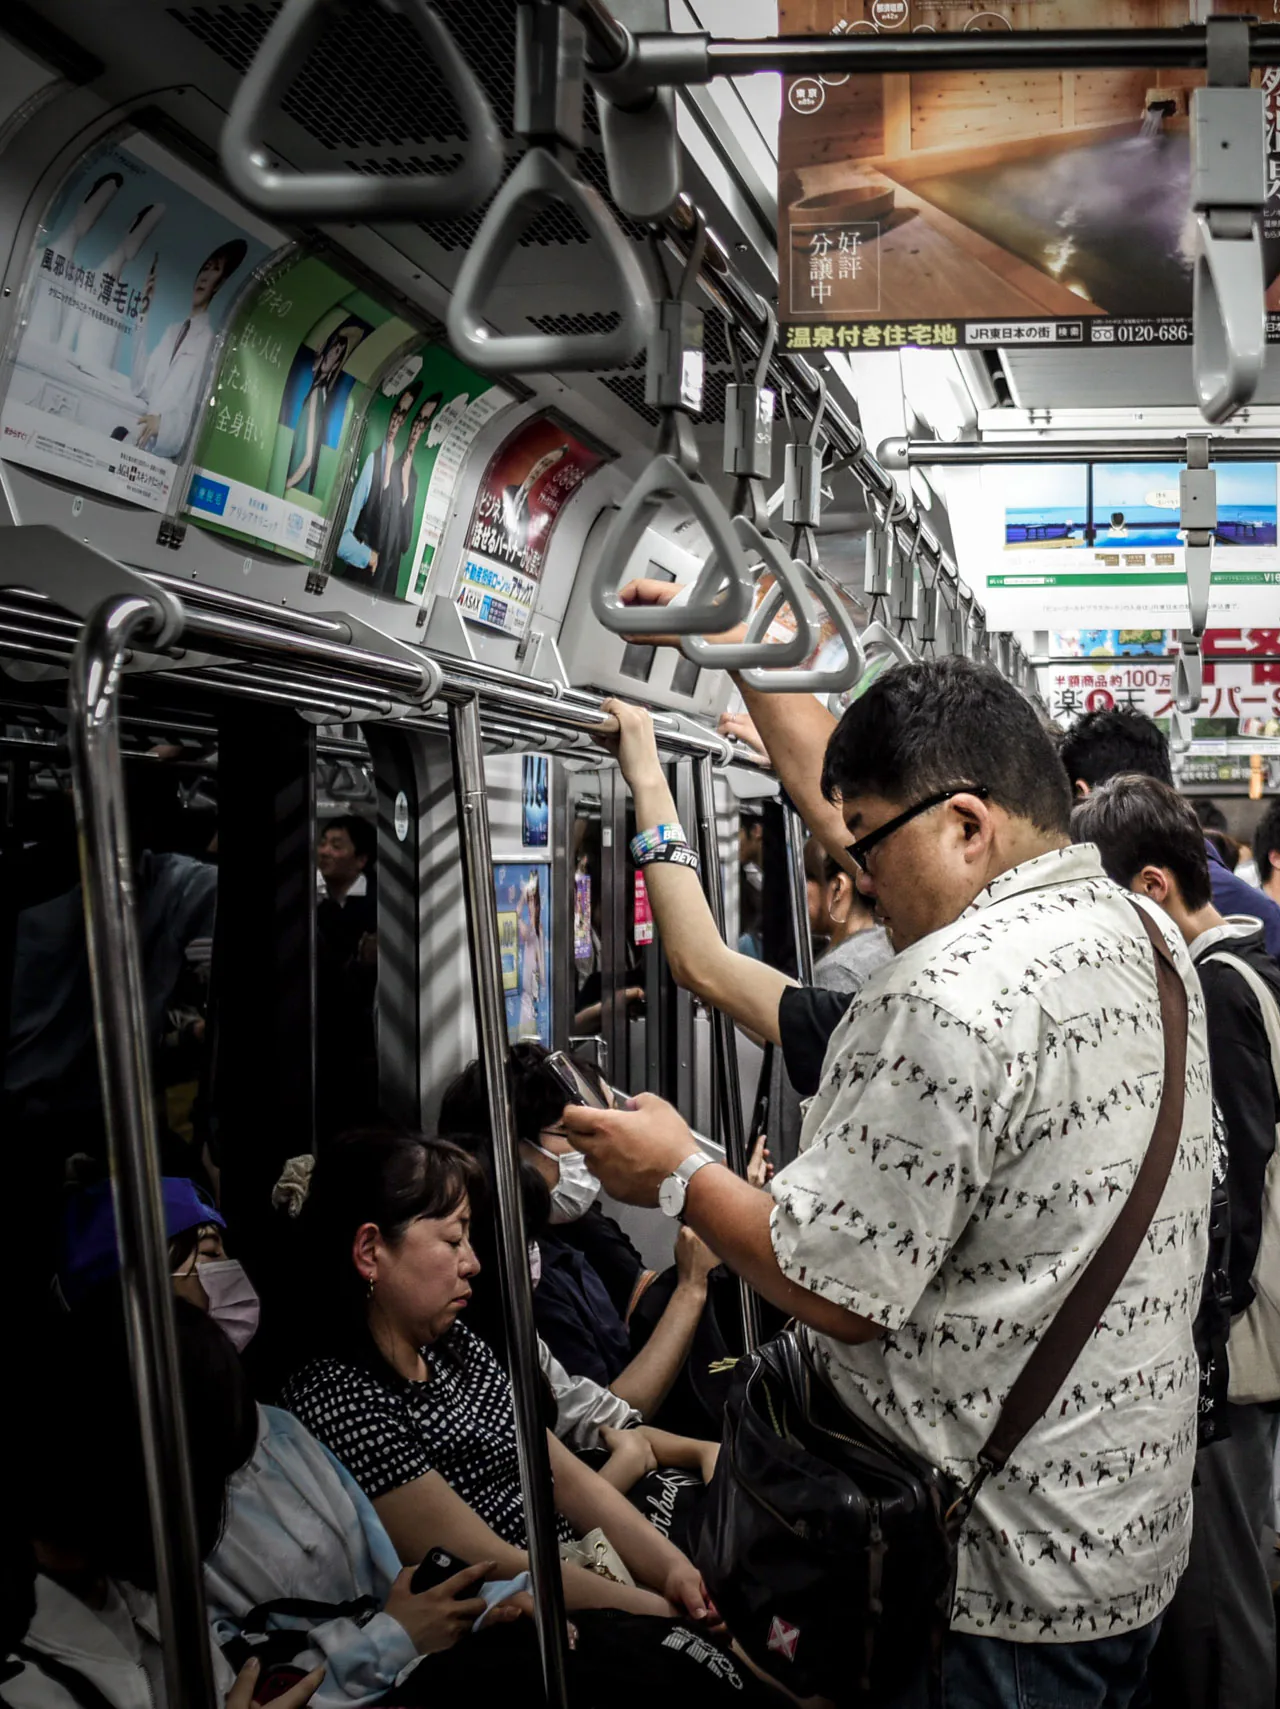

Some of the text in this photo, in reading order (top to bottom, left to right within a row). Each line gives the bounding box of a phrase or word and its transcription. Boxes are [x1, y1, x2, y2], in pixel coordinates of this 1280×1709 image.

[838, 231, 863, 280] 好評
[809, 232, 834, 305] 分譲中
[785, 324, 958, 349] 温泉付き住宅地
[969, 325, 1051, 341] JR東日本の街
[1118, 325, 1194, 342] 0120-686-
